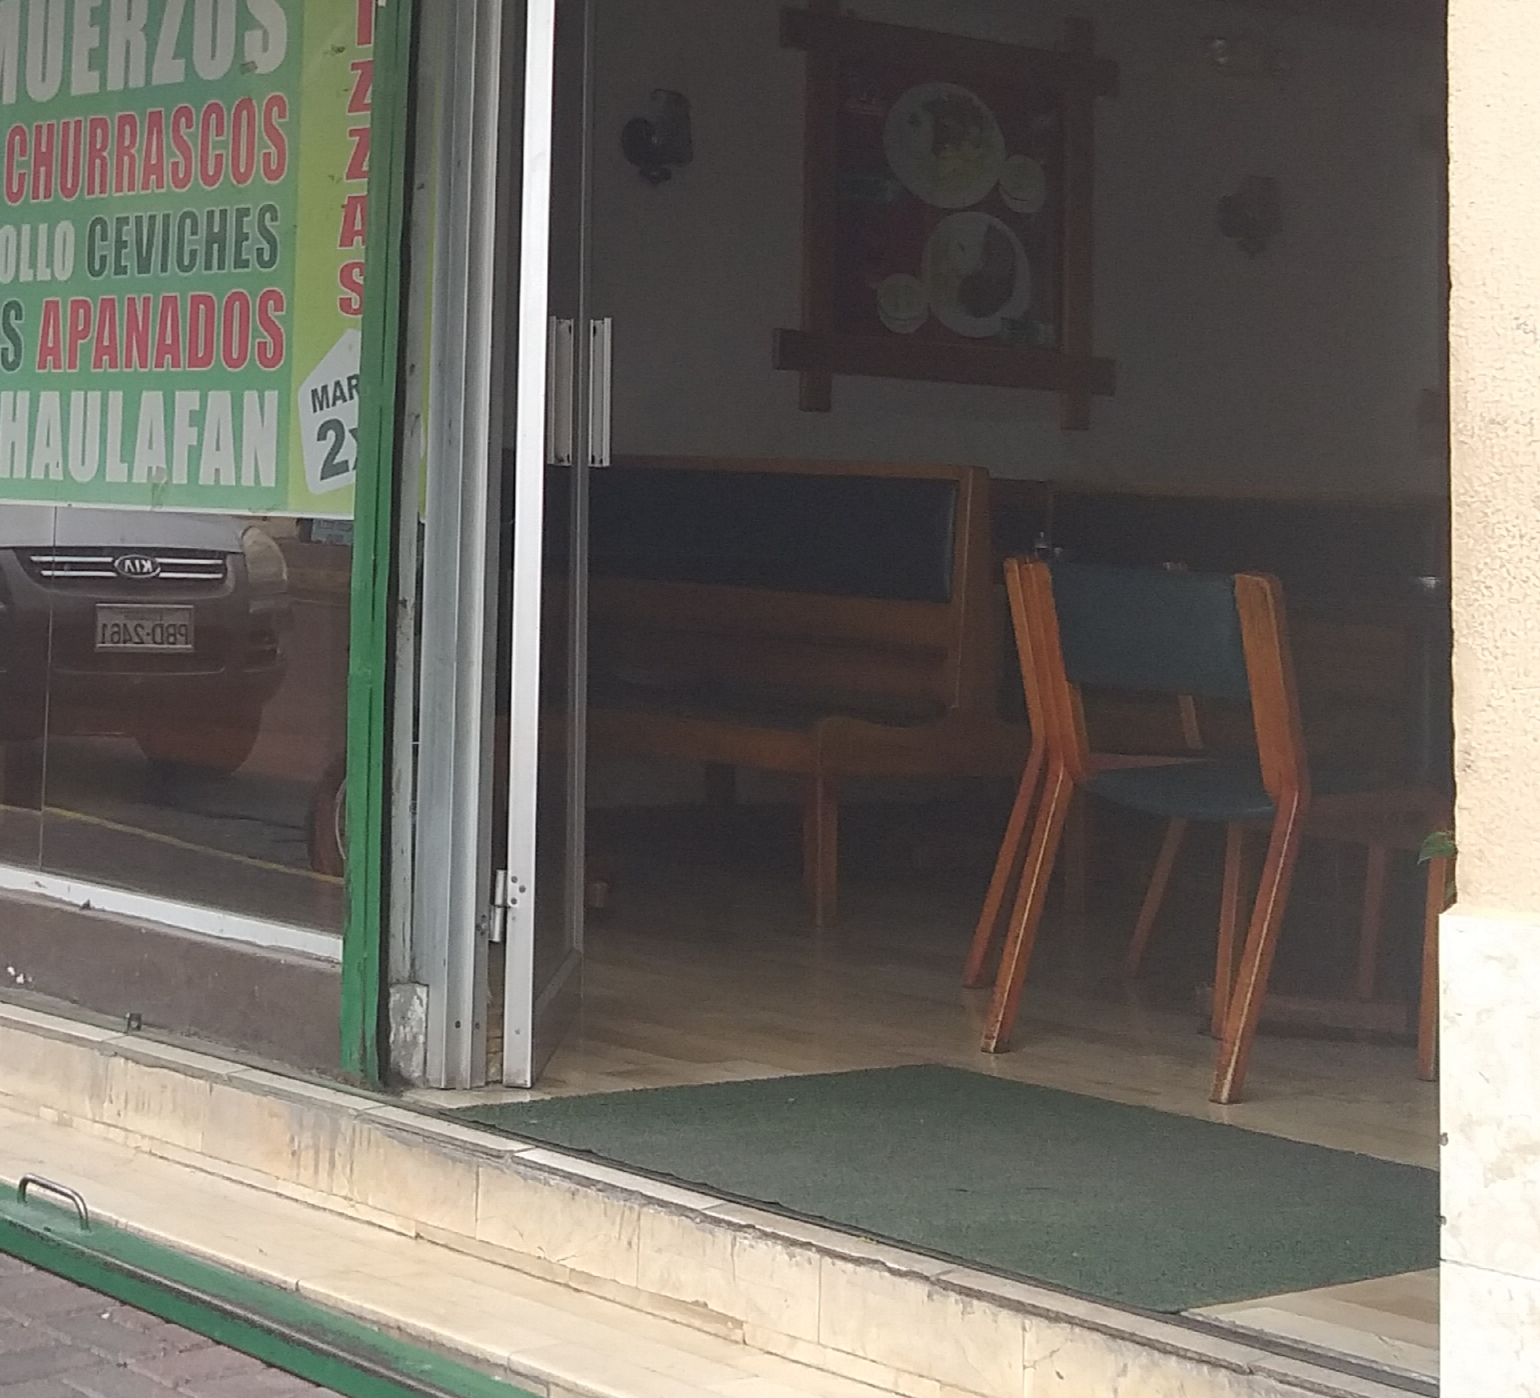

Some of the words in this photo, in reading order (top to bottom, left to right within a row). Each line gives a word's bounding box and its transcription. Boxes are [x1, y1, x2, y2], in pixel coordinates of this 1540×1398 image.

[4, 93, 288, 204] CHURRASCOS
[85, 202, 280, 279] CEVICHES
[35, 288, 286, 372] APANADOS
